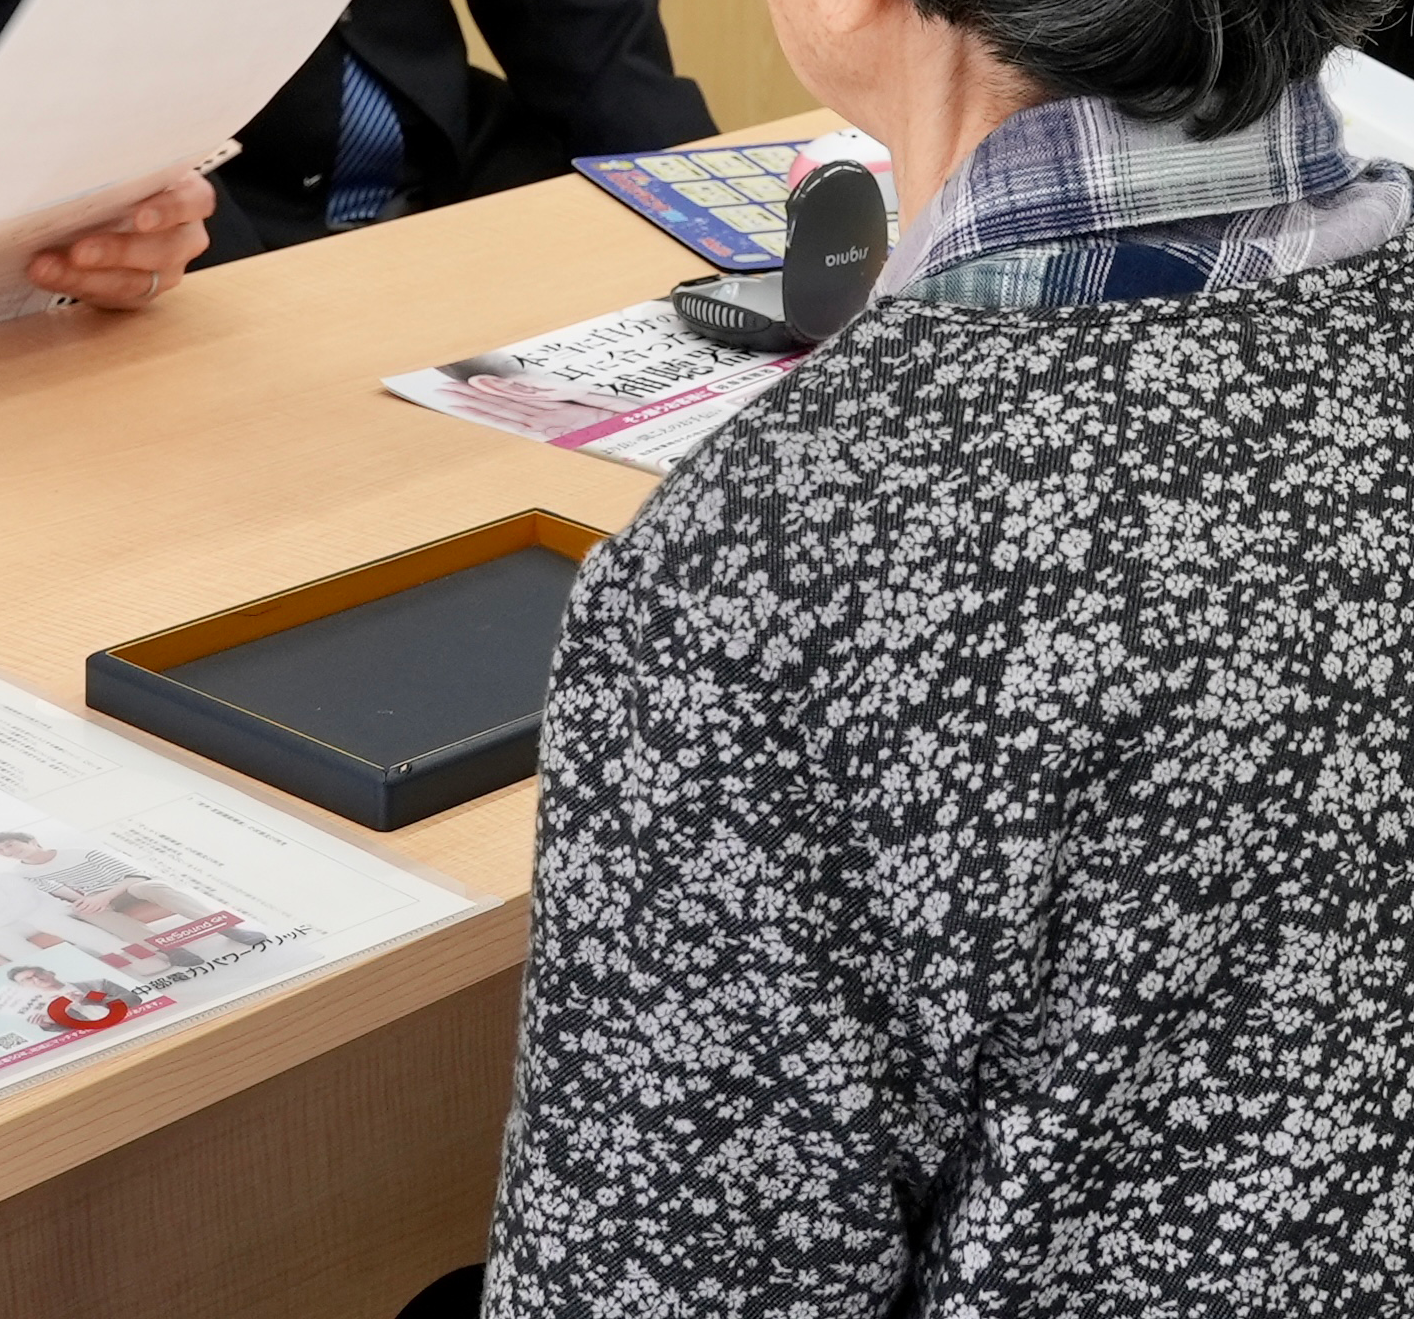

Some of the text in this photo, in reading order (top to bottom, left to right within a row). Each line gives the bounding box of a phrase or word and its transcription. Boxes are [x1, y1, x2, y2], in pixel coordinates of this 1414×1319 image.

[825, 245, 869, 267] signia
[511, 312, 681, 369] 本当に自分の
[551, 331, 706, 381] 耳に合った
[593, 343, 760, 399] 補聴器
[155, 919, 208, 947] ReSound
[130, 922, 313, 998] 中部電力パワーグリッド
